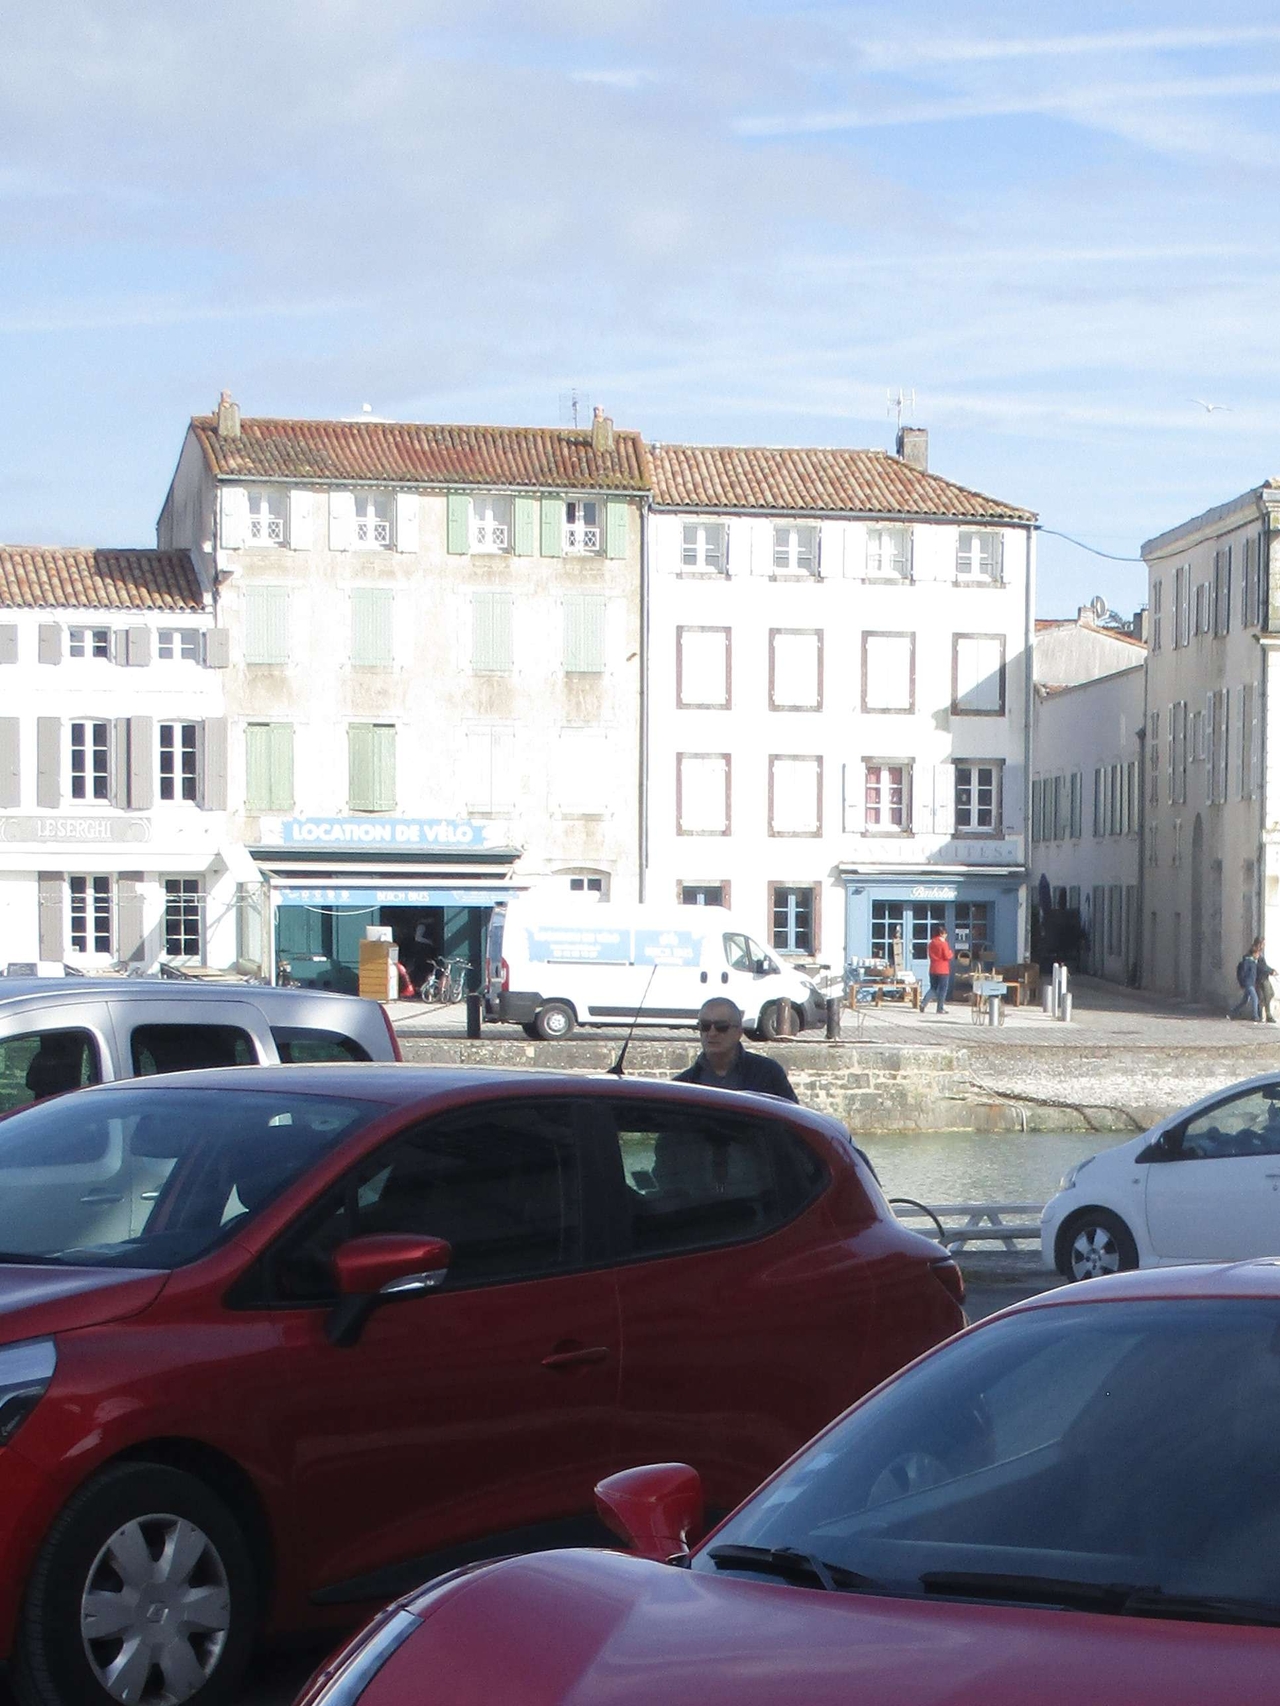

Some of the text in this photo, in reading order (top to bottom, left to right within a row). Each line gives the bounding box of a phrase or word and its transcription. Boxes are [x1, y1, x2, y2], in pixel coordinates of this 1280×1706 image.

[37, 819, 112, 838] LE SERGHI
[292, 821, 474, 843] LOCATION DE VÉLO
